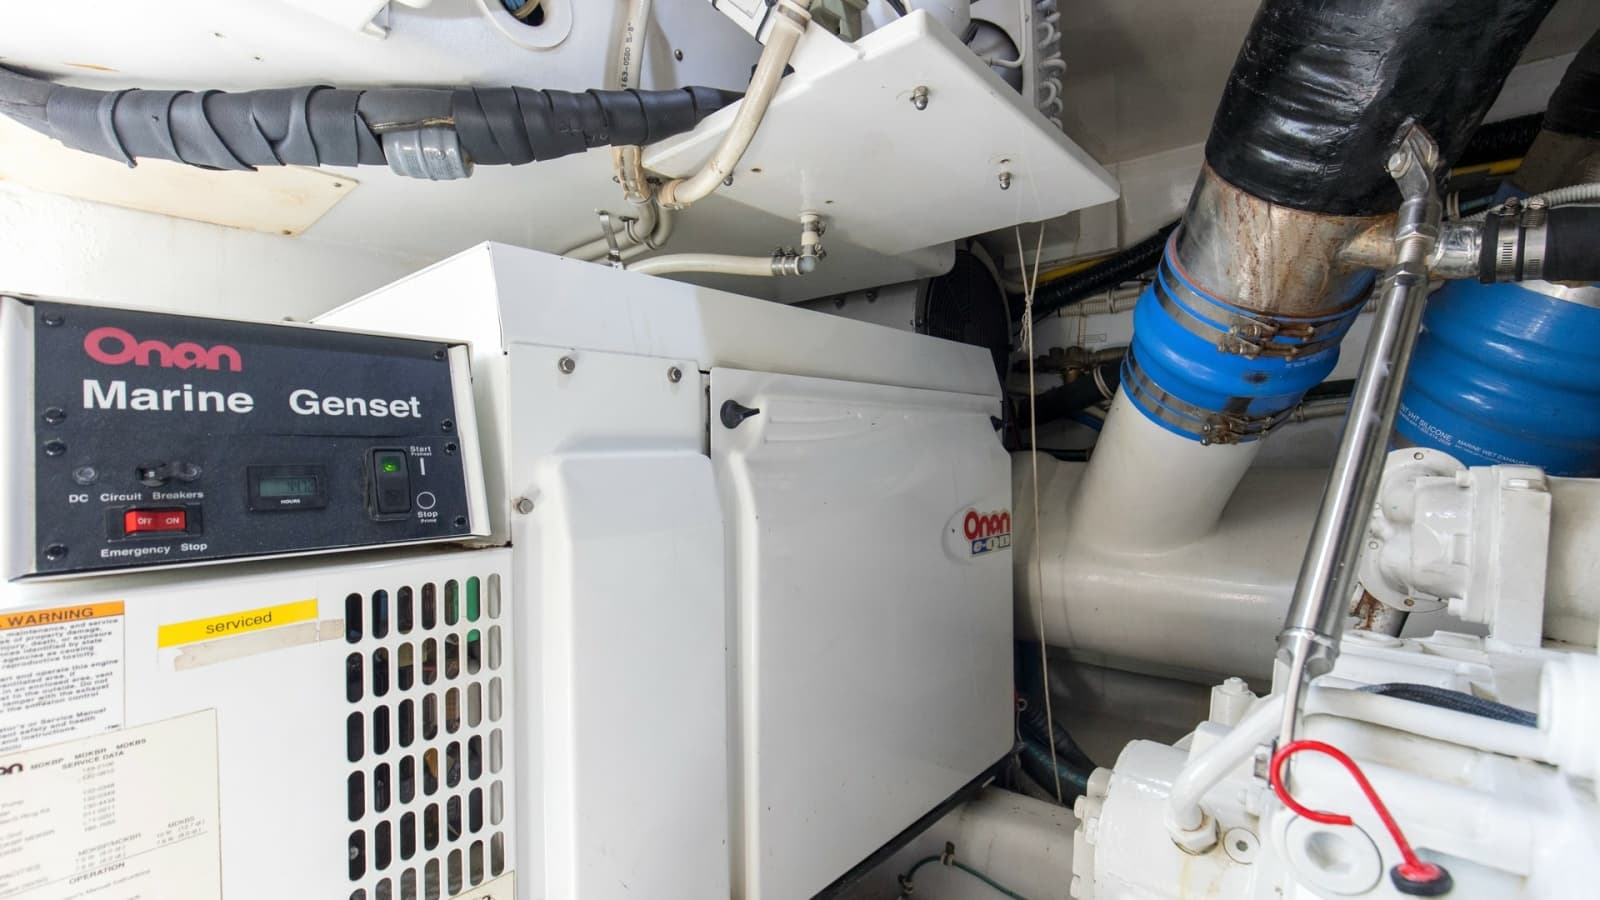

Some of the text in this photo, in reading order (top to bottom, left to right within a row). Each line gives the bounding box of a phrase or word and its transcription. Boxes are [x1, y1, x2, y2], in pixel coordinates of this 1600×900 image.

[83, 327, 242, 373] Onan
[82, 378, 422, 419] Marine Genset
[1419, 419, 1454, 442] SILICONE
[410, 445, 431, 453] Start
[69, 491, 204, 503] DC Circuit Breakers
[137, 517, 180, 525] OFF ON
[417, 511, 438, 519] Stop
[964, 511, 1011, 540] Onan
[100, 543, 208, 558] Emergency Stop
[8, 607, 94, 627] WARNING
[206, 611, 272, 634] serviced
[70, 622, 86, 630] and
[89, 618, 118, 627] service
[25, 632, 64, 643] property
[73, 631, 112, 642] exposure
[91, 659, 119, 668] engine
[76, 707, 107, 718] Manual
[62, 756, 100, 770] SERVICE
[103, 750, 125, 760] DATA
[68, 862, 125, 885] OPERATION
